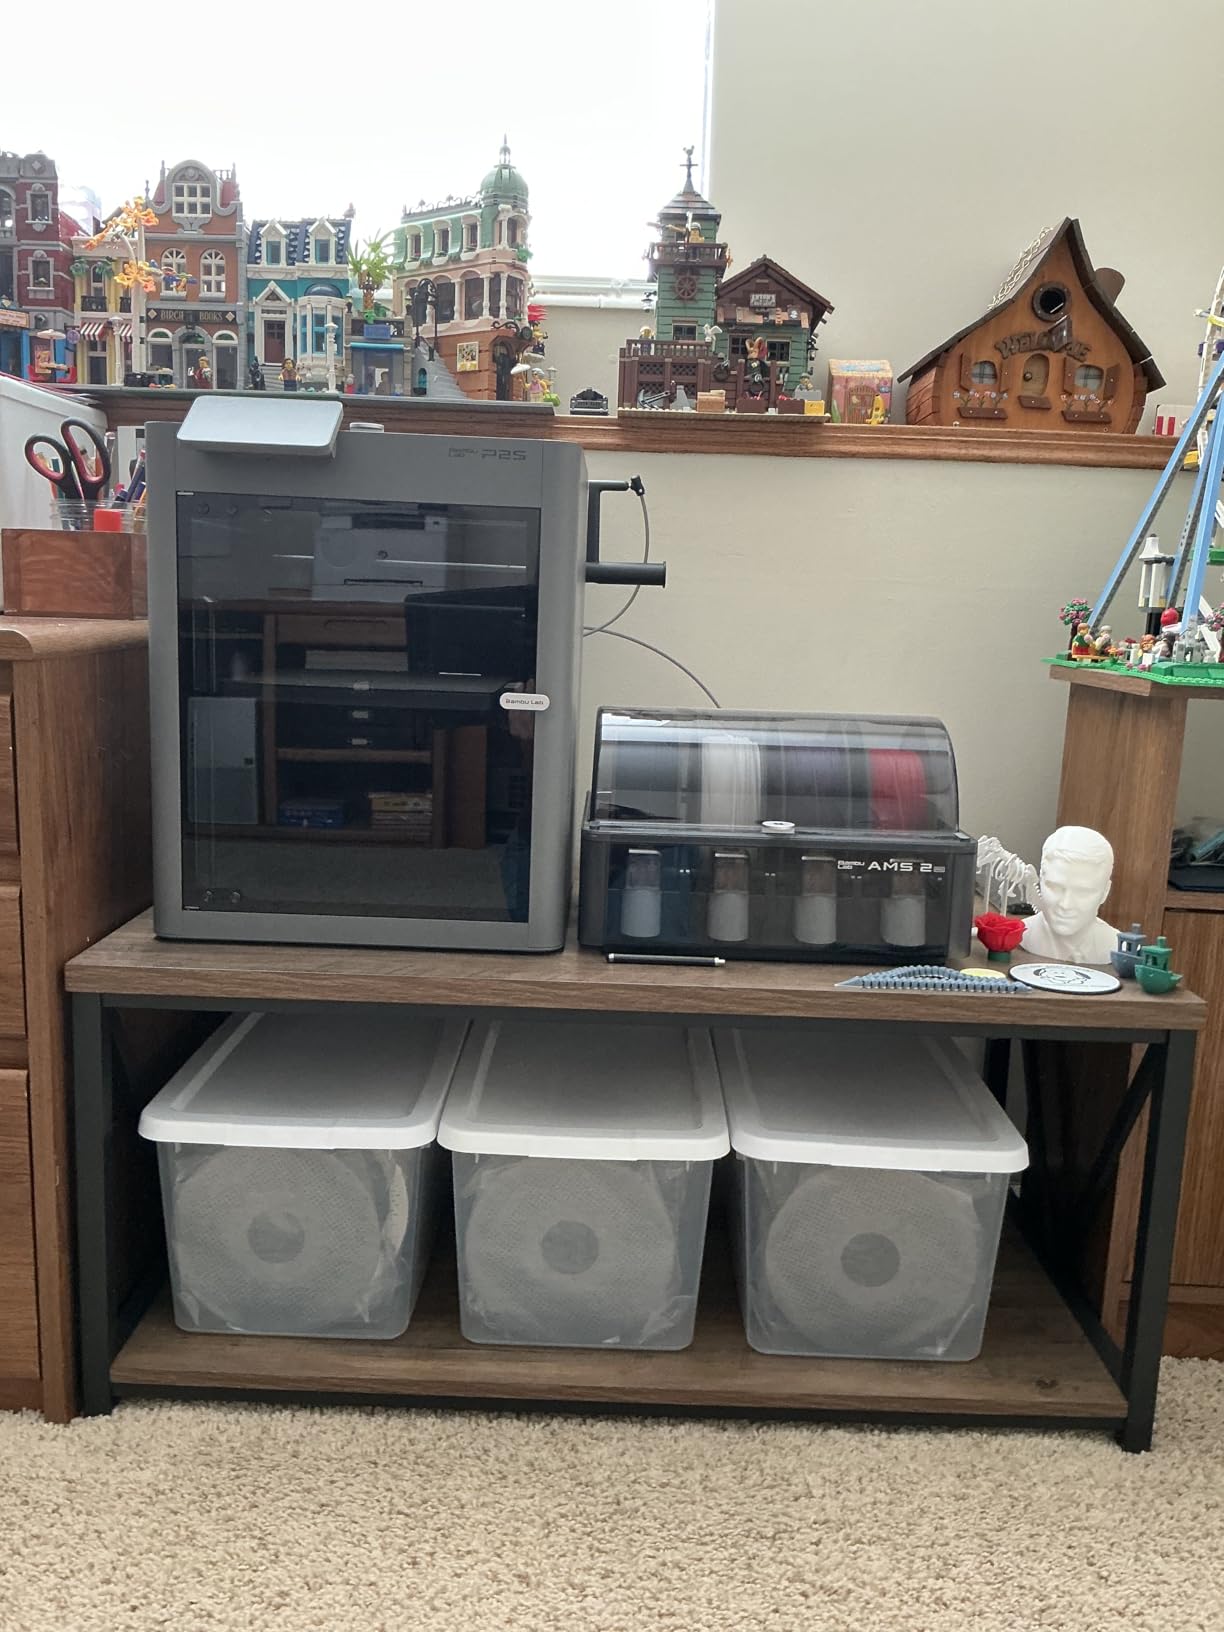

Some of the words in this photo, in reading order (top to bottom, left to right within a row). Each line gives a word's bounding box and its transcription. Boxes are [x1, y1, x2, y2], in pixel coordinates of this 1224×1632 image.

[160, 310, 184, 321] BIRCH
[199, 311, 223, 321] BOOKS
[994, 331, 1092, 362] WELCME
[481, 449, 527, 461] P2S
[867, 861, 914, 872] AMS
[919, 863, 933, 873] 2
